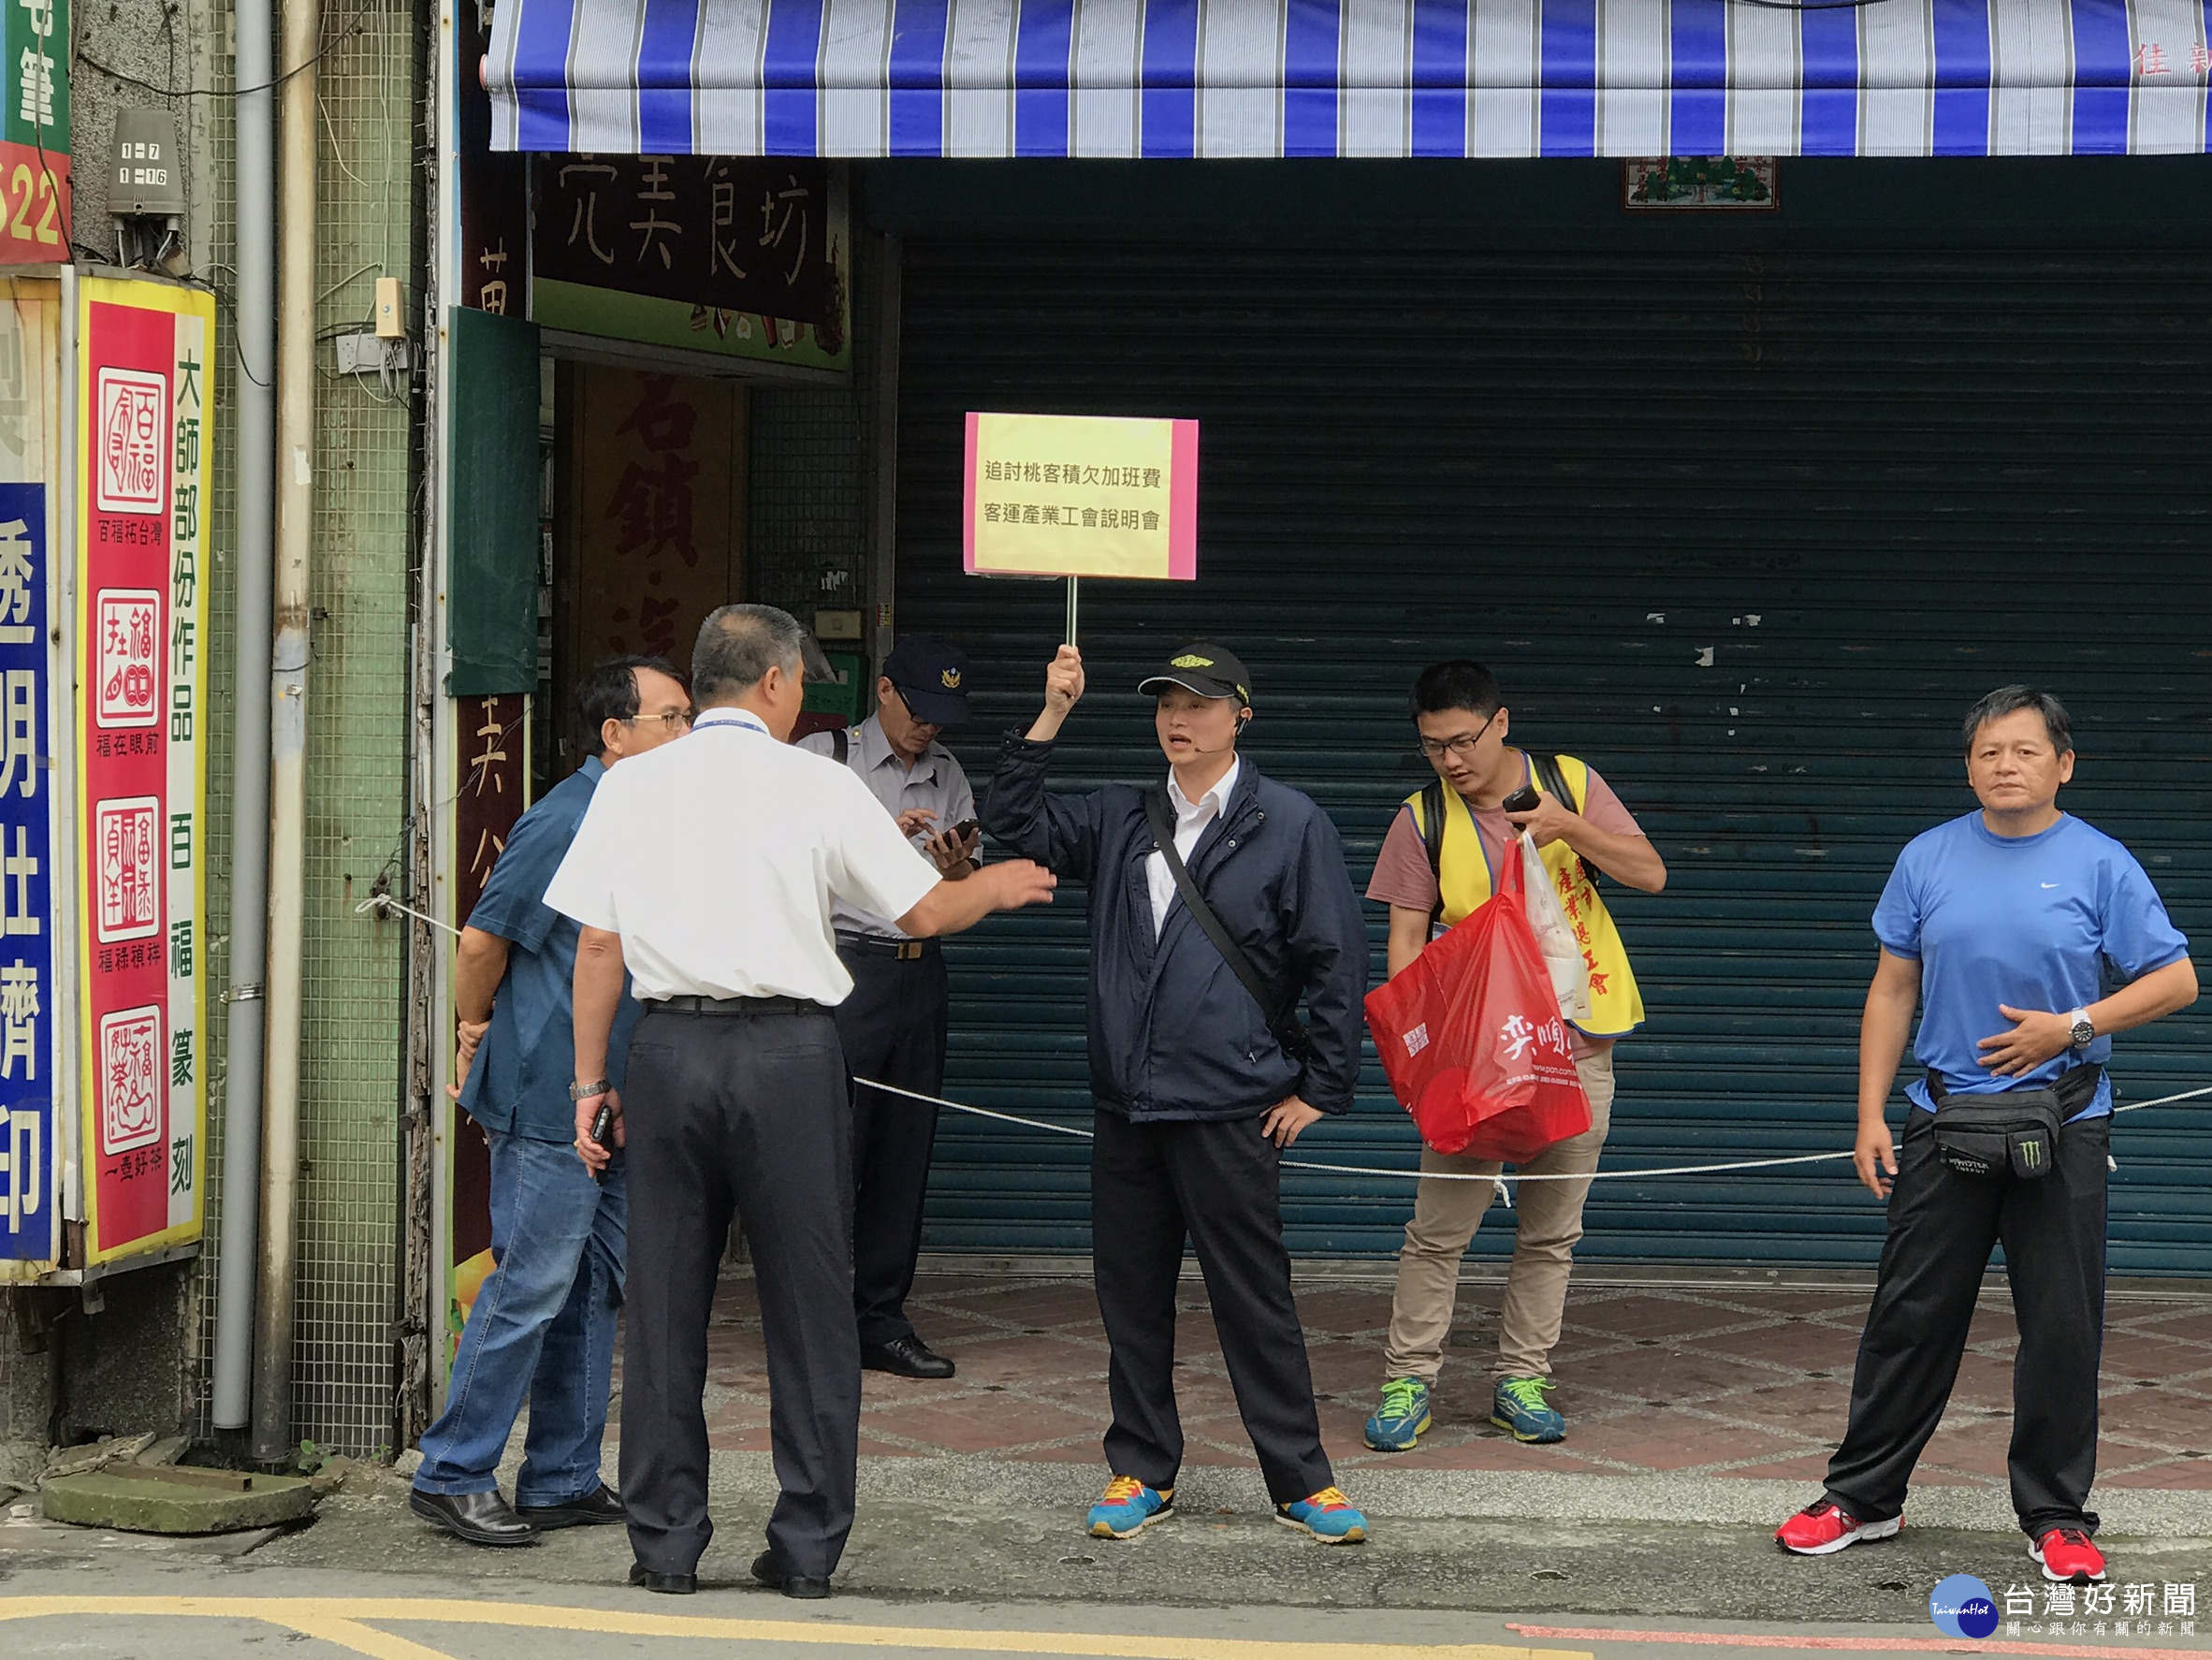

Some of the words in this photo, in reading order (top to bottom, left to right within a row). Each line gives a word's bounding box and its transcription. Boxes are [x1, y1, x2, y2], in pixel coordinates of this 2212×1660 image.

[984, 459, 1161, 488] 追討桃客積欠加班費
[983, 502, 1160, 531] 客運產業工會說明會
[170, 347, 201, 742] 大師部份作品
[95, 731, 160, 758] 福在眼前
[98, 941, 162, 974] 福祿禎祥
[168, 811, 195, 1195] 百福篆刻
[104, 1147, 162, 1183] 一壺好茶
